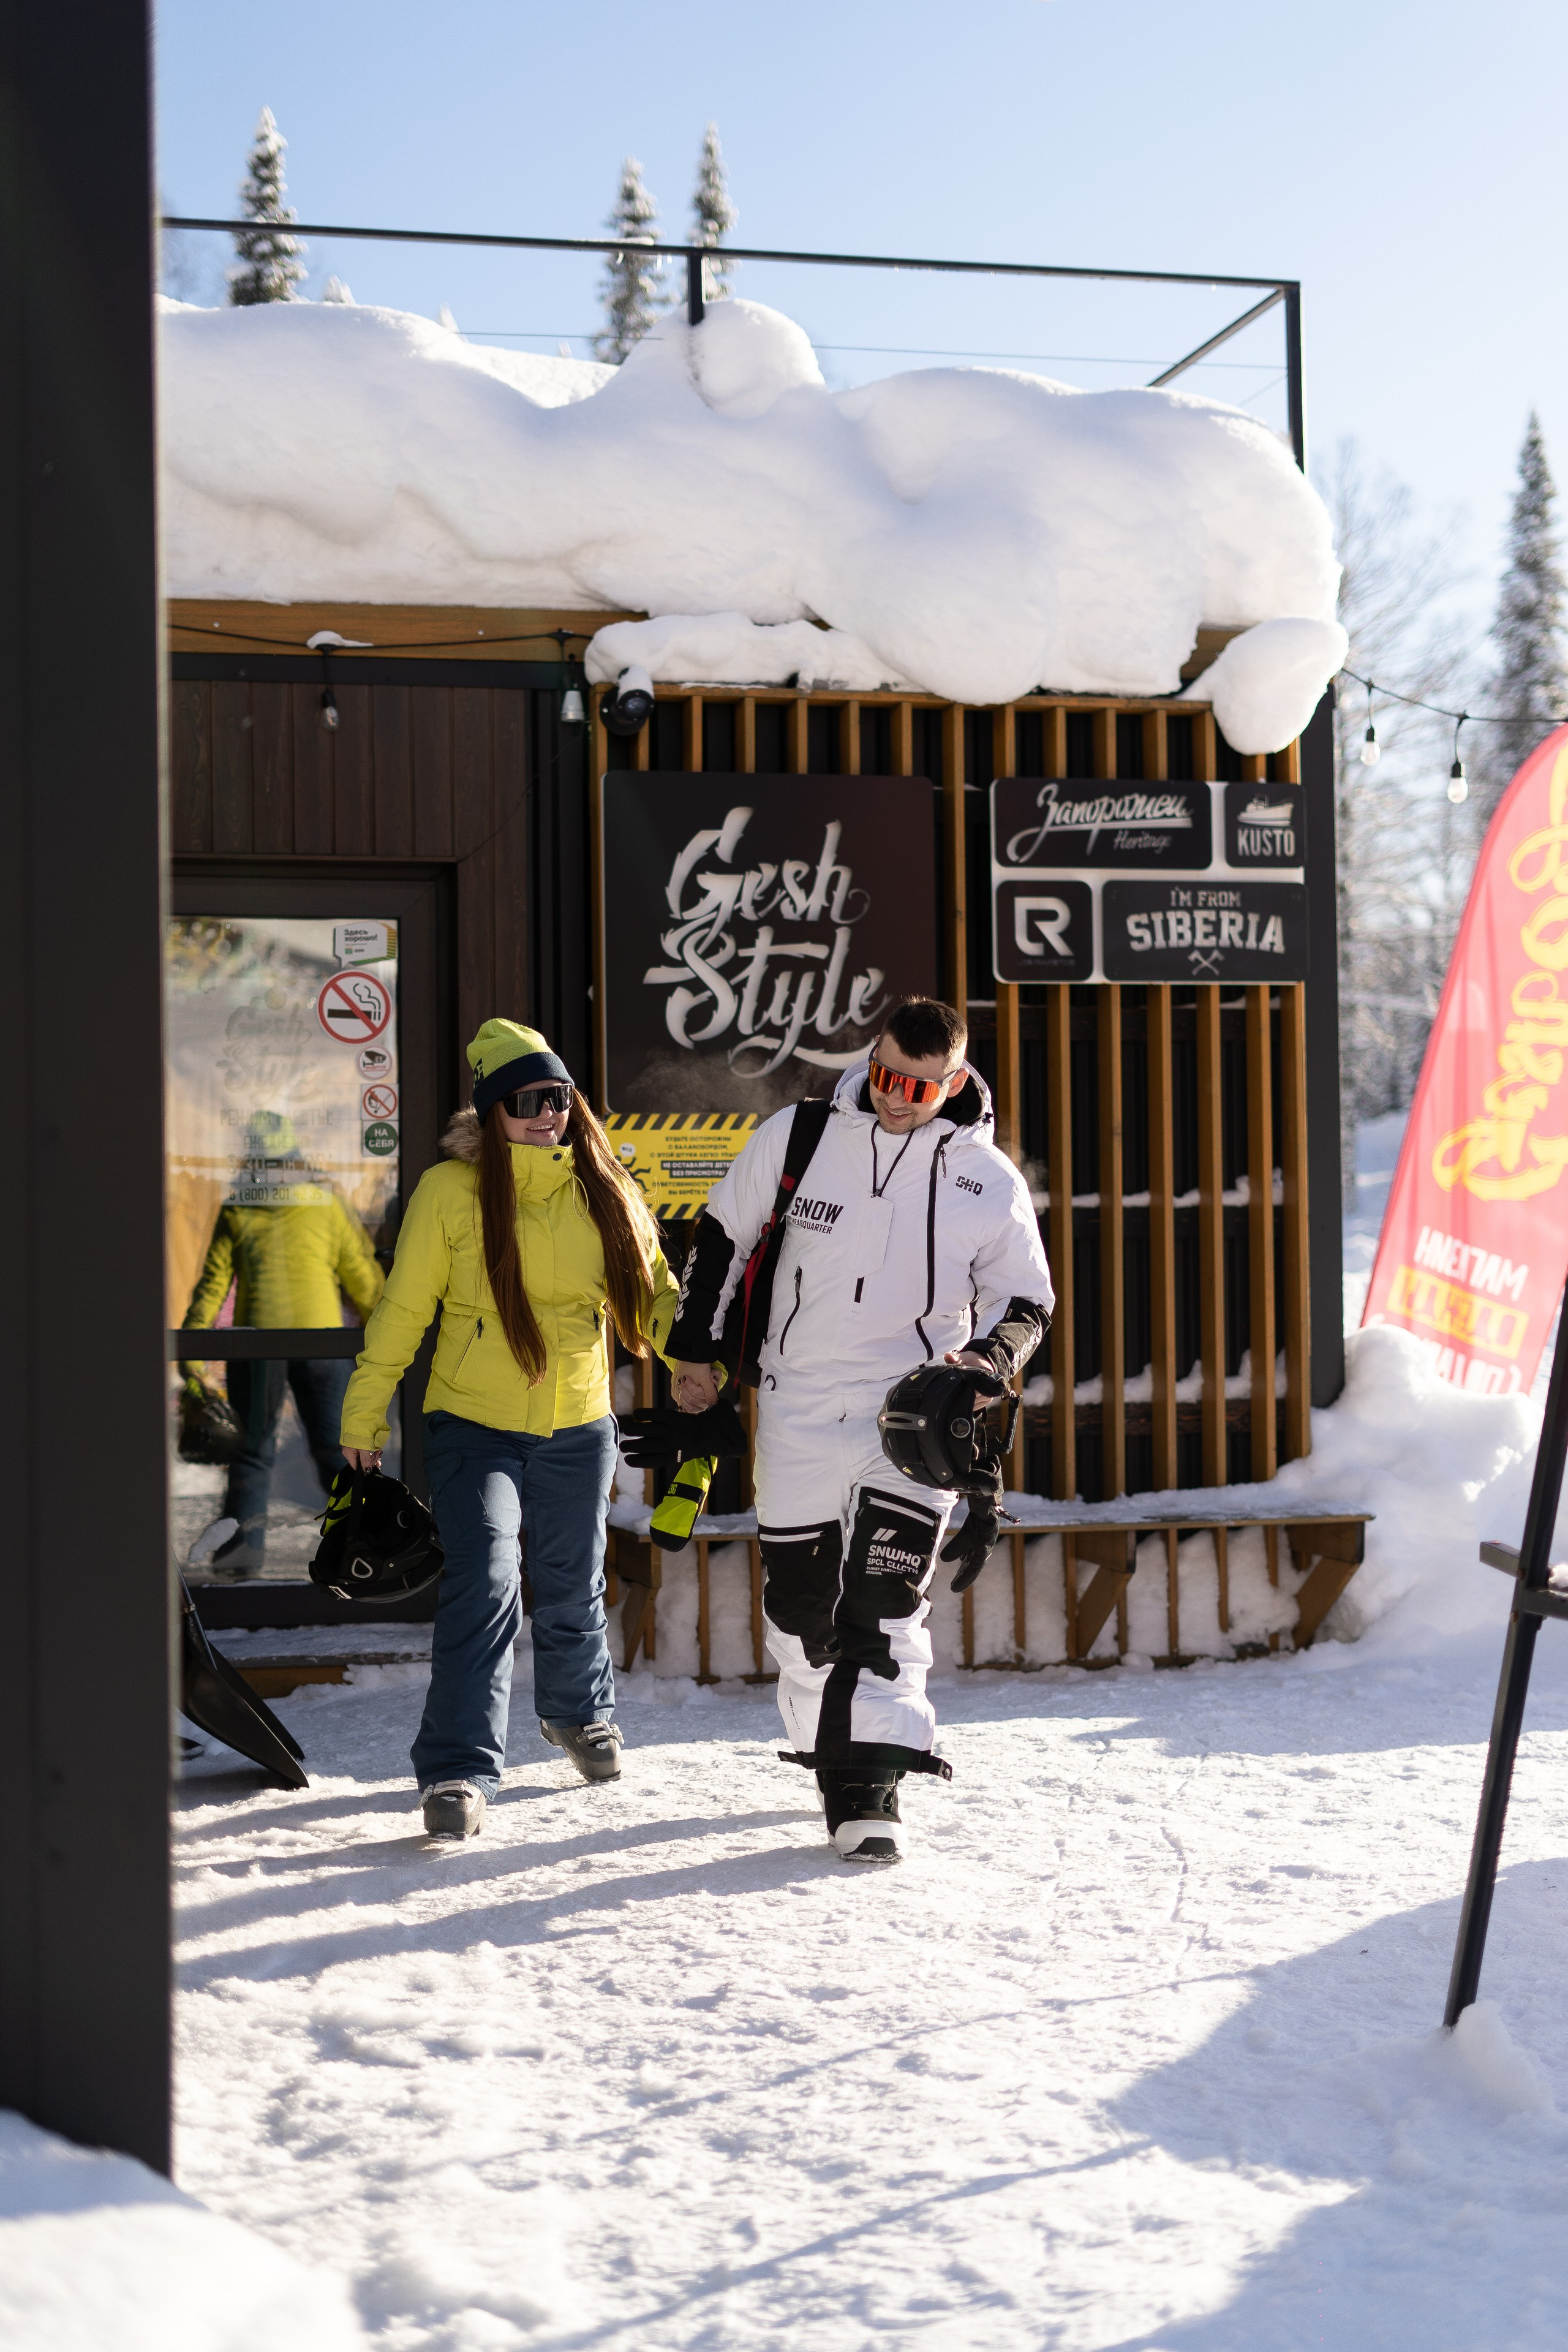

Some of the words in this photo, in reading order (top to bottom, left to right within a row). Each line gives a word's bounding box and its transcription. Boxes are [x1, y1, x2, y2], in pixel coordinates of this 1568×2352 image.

[1113, 830, 1173, 854] Heritage
[1237, 827, 1295, 858] KUSTO
[665, 807, 871, 953] Gesh
[1170, 886, 1193, 907] I'M
[1196, 889, 1242, 908] FROM
[1126, 910, 1286, 954] SIBERIA
[643, 925, 892, 1079] Style
[369, 1139, 394, 1148] СЕБЯ
[374, 1128, 388, 1137] НА
[239, 1187, 268, 1203] (800)
[273, 1188, 290, 1201] 201
[791, 1196, 845, 1224] SNOW
[867, 1558, 884, 1566] SPCL
[886, 1561, 919, 1575] CLLCTN
[869, 1545, 921, 1569] SNWHQ
